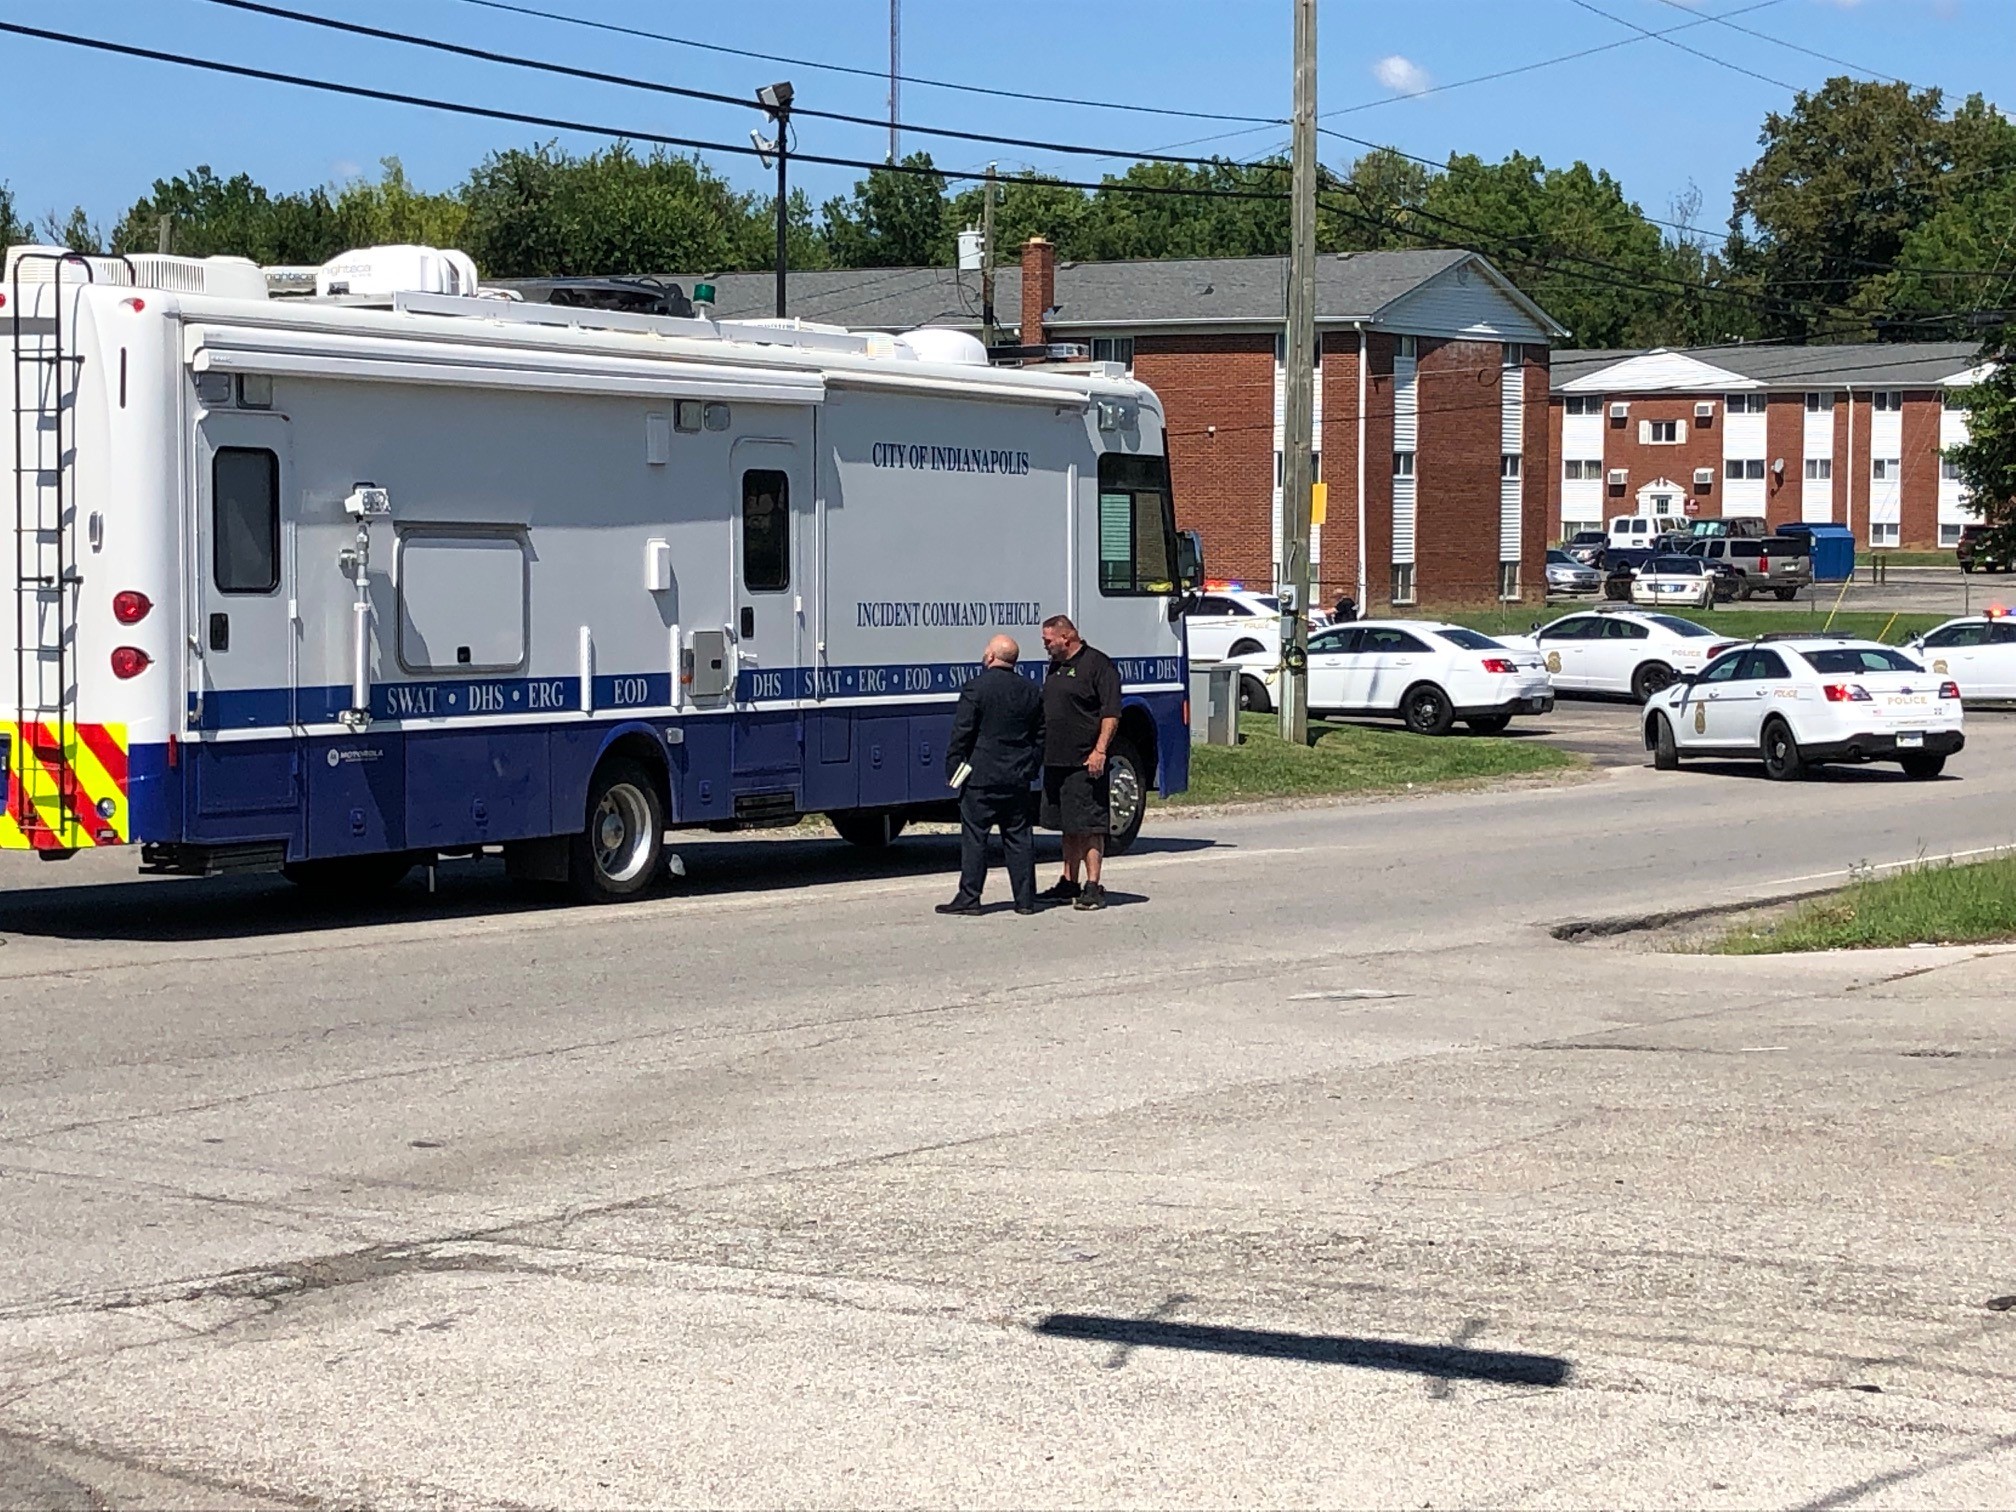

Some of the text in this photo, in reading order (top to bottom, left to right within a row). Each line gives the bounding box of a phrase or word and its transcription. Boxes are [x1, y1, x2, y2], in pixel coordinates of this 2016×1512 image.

[872, 442, 1029, 475] CITY OF INDIANAPOLIS
[856, 602, 1041, 627] INCIDENT COMMAND VEHICLE
[1671, 649, 1702, 657] POLICE
[386, 686, 438, 715] SWAT
[468, 683, 504, 711] DHS
[528, 681, 564, 708] ERG
[614, 678, 648, 704] EOD
[752, 673, 782, 697] DHS
[804, 670, 842, 694] SWAT
[858, 668, 887, 692] ERG
[904, 667, 932, 690] EOD
[1117, 660, 1146, 681] SWAT
[1156, 658, 1177, 680] DHS
[1773, 689, 1798, 698] POLICE
[1887, 696, 1928, 705] POLICE
